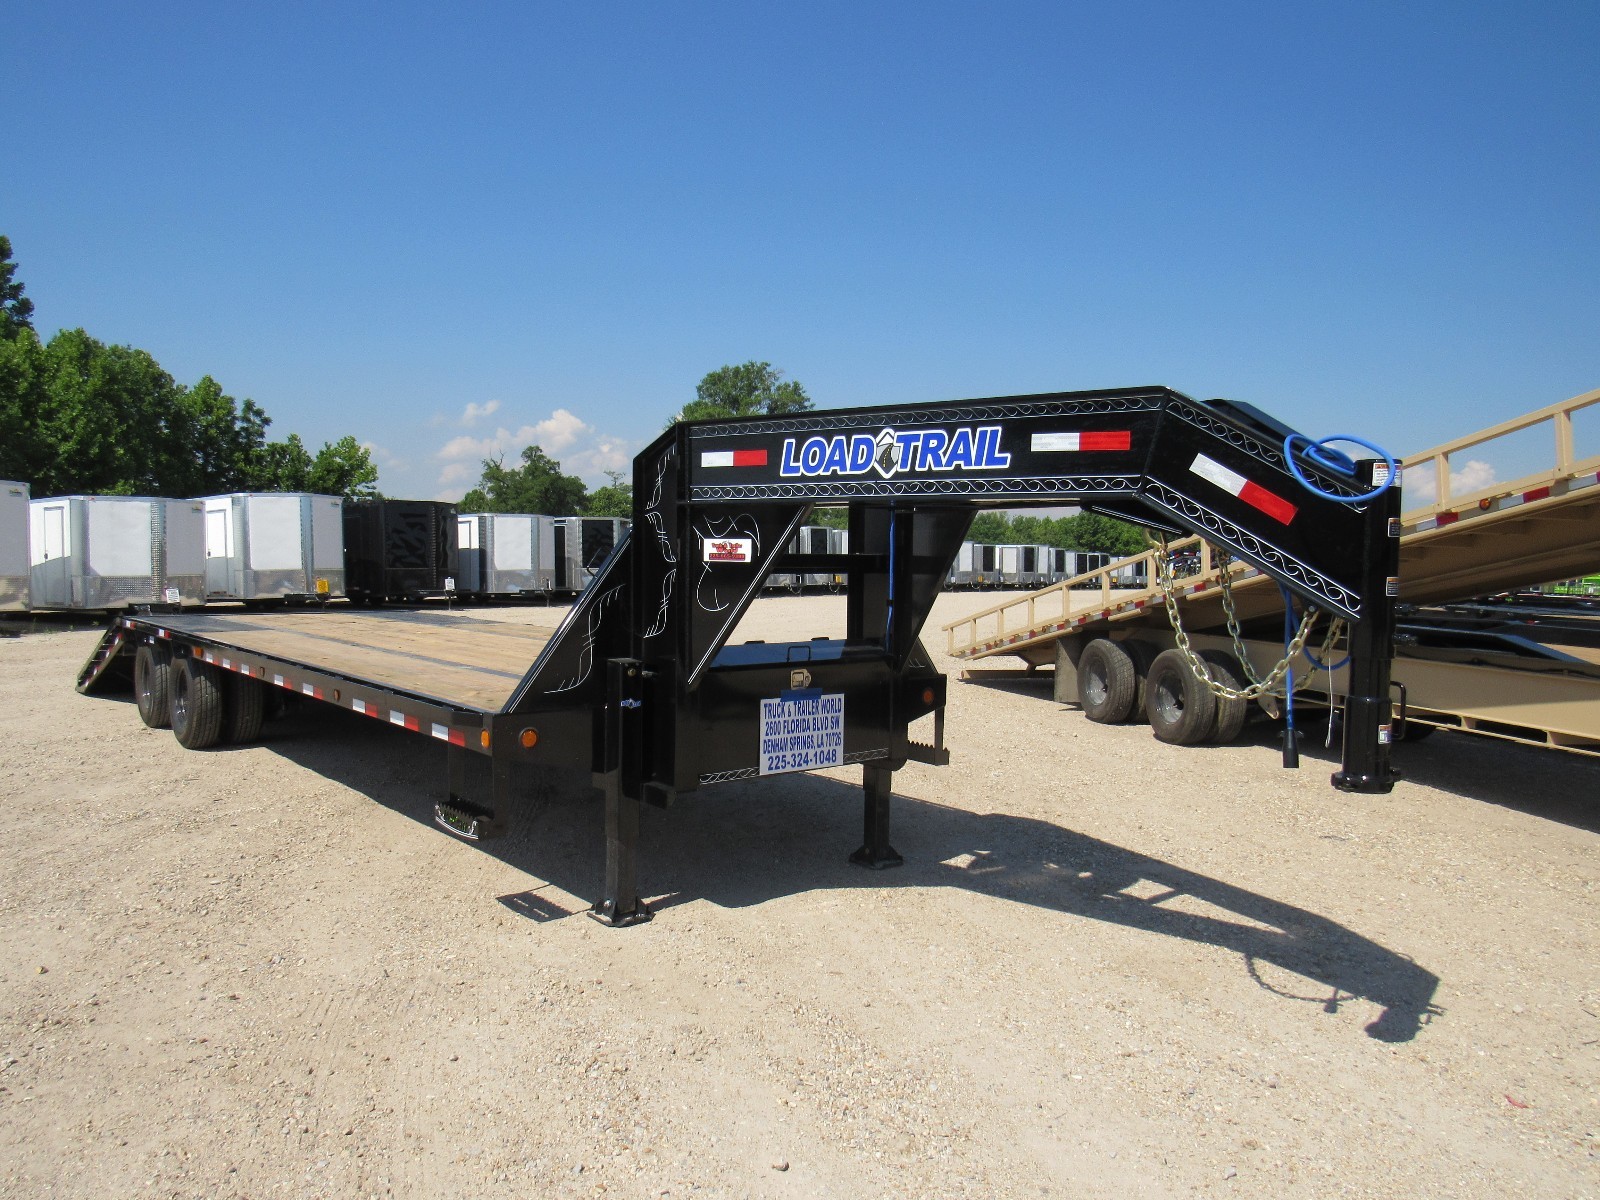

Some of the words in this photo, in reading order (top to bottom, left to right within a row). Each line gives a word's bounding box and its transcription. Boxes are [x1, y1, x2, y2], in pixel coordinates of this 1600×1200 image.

[780, 435, 877, 477] LOAD
[893, 427, 1011, 472] TRAIL
[763, 701, 786, 719] TRUCK
[787, 704, 792, 717] &
[793, 699, 820, 717] TRAILER
[820, 698, 842, 714] WORLD
[765, 720, 781, 736] 2600
[782, 718, 811, 734] FLORIDA
[812, 716, 829, 731] BLVD
[830, 715, 840, 730] SW
[763, 736, 789, 754] DENHAM
[789, 734, 816, 751] SPRINGS,
[816, 733, 825, 748] LA
[825, 732, 842, 747] 70726
[767, 748, 837, 771] 225-324-1048
